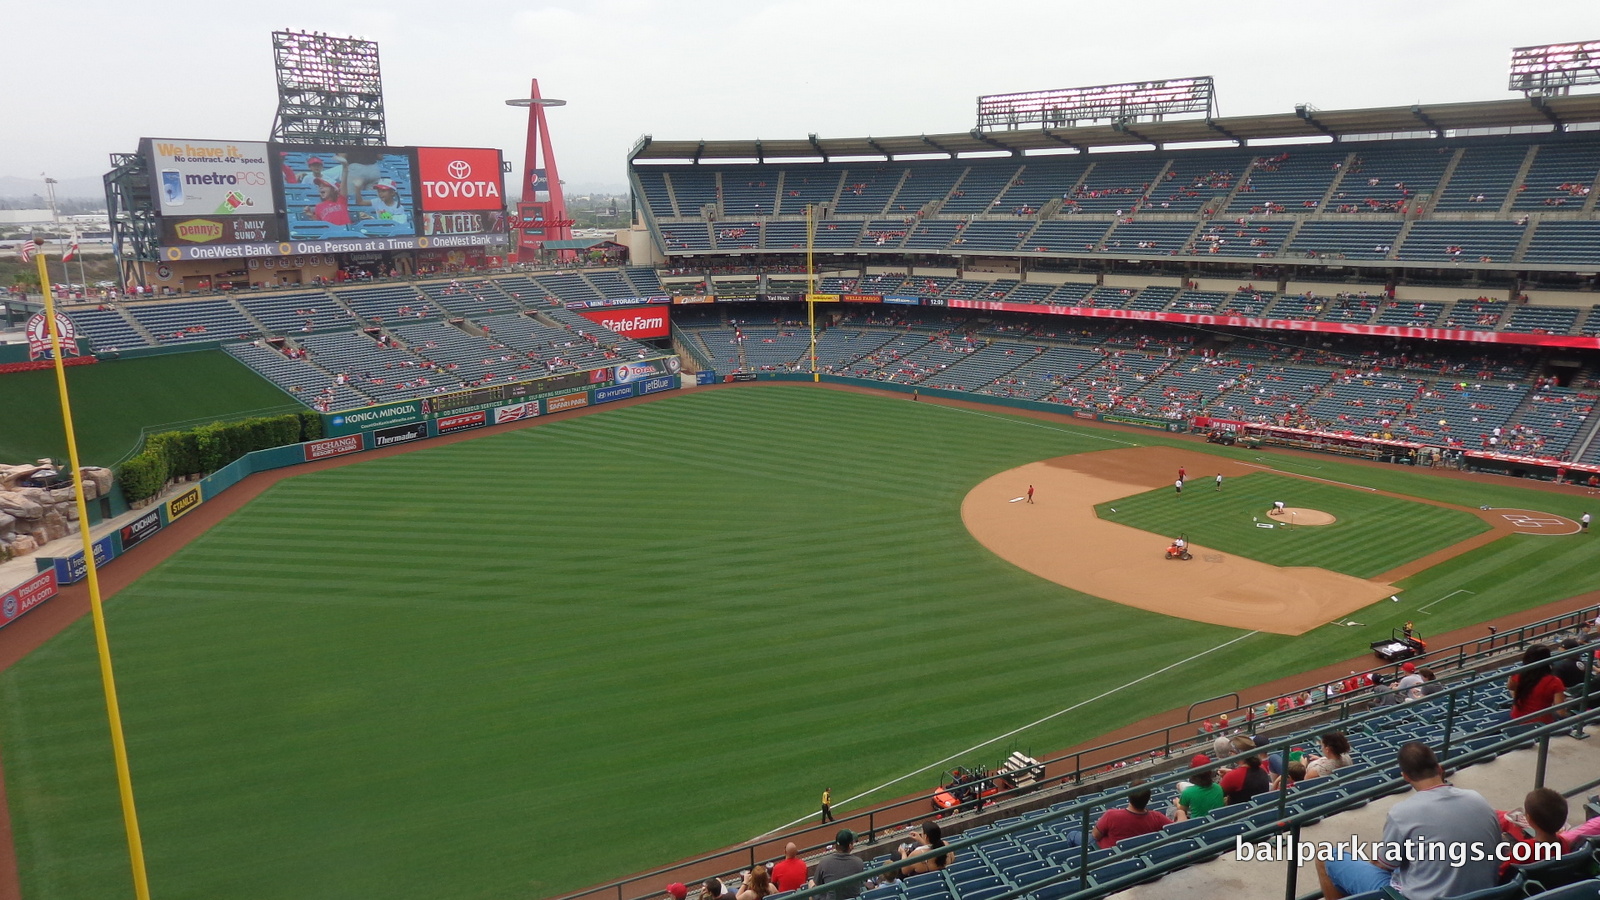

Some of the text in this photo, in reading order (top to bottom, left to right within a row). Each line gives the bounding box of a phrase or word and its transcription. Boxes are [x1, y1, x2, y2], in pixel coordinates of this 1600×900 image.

[157, 144, 243, 158] We have it.
[240, 157, 265, 165] speed.
[185, 171, 266, 186] metroPCS
[423, 181, 499, 198] TOYOTA
[179, 224, 220, 237] Denny's
[233, 219, 265, 230] FAMILY
[432, 213, 482, 235] ANGELS
[234, 230, 266, 240] SUNDAY
[433, 236, 469, 248] OneWest
[471, 234, 491, 246] Bank
[190, 243, 273, 259] OneWest Bank
[298, 238, 413, 254] One Person at a Time
[28, 314, 42, 332] WEST
[631, 365, 657, 374] TOTAL
[606, 387, 631, 397] HYUNDAI
[645, 379, 668, 393] jetBlue
[549, 400, 570, 410] SAFARI
[570, 398, 587, 406] PARK
[344, 405, 416, 424] KONICA MINOLTA
[310, 437, 357, 452] PECHANGA
[376, 431, 418, 445] Thermador
[312, 445, 357, 457] RESORT CASINO
[172, 491, 197, 513] STANLEY
[130, 512, 158, 533] YOKOHAMA
[19, 575, 50, 597] Insurance
[21, 587, 52, 610] AAA.com
